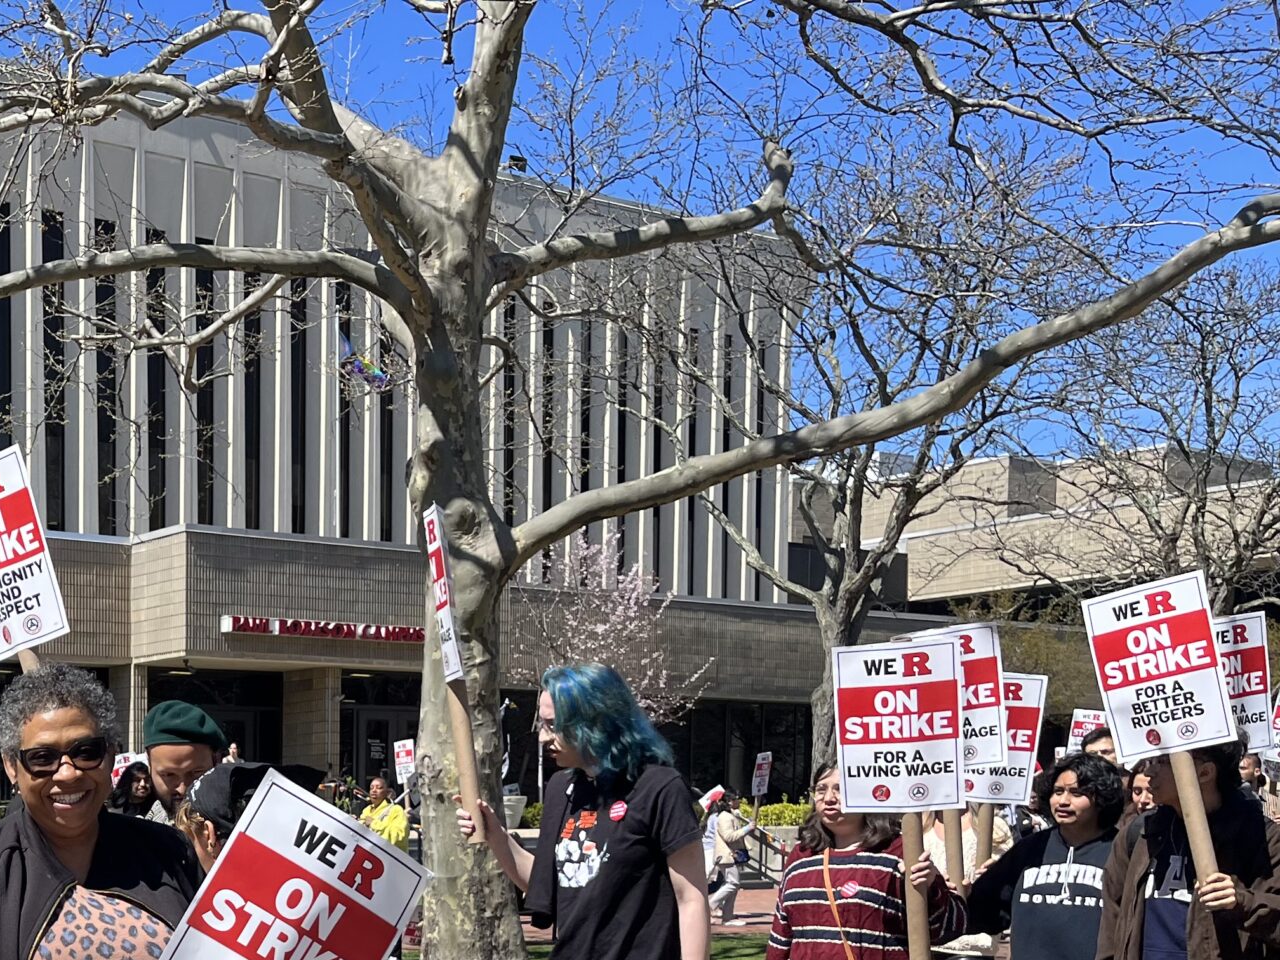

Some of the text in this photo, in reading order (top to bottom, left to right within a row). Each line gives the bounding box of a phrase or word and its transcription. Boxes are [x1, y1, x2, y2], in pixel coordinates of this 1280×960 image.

[427, 518, 437, 545] R
[1112, 590, 1176, 621] WE R
[279, 619, 357, 639] ROBESON
[1126, 623, 1171, 654] ON
[1232, 623, 1249, 645] R
[863, 651, 932, 677] WE R
[1104, 640, 1211, 685] STRIKE
[1004, 682, 1023, 701] R
[1135, 680, 1185, 700] FOR A
[1226, 671, 1264, 695] RIKE
[874, 689, 918, 715] ON
[1131, 692, 1195, 715] BETTER
[1240, 703, 1246, 714] A
[844, 710, 952, 740] STRIKE
[963, 717, 972, 728] A
[1131, 704, 1205, 729] RUTGERS
[1237, 711, 1266, 726] WAGE
[874, 750, 924, 764] FOR A
[847, 765, 901, 778] LIVING
[905, 761, 954, 776] WAGE
[989, 767, 1027, 778] WAGE
[293, 818, 385, 900] WE R
[1023, 863, 1104, 890] WESTFIEL
[275, 877, 346, 942] ON
